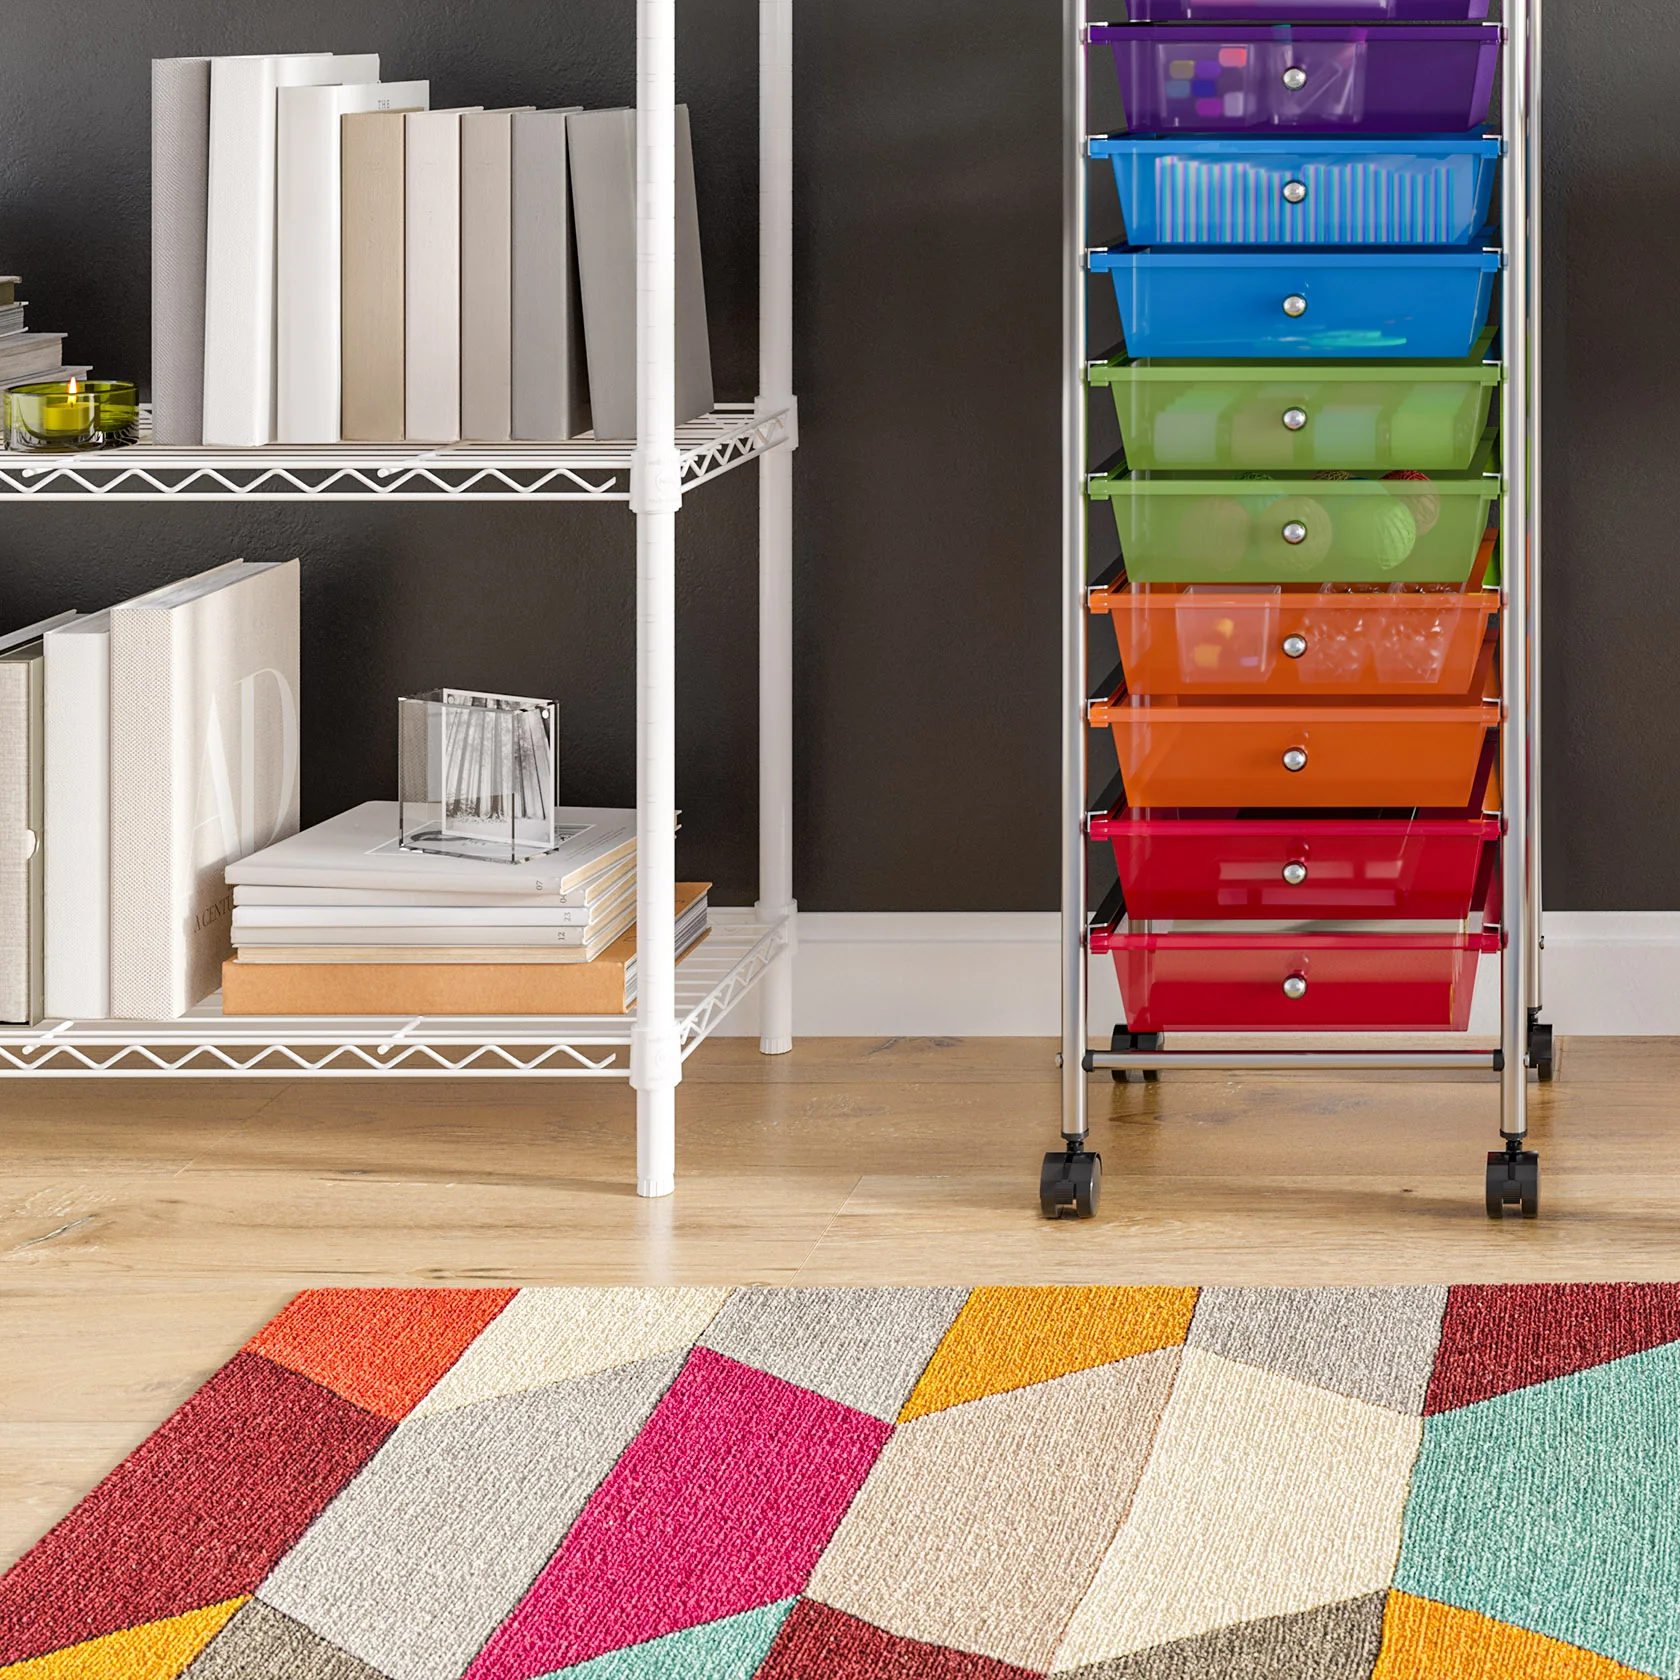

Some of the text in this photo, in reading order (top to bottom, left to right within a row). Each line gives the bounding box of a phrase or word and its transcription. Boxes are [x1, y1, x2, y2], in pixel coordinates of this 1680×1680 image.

[377, 99, 391, 109] THE
[182, 668, 298, 898] AD
[535, 879, 544, 891] 07
[563, 911, 572, 922] 23
[557, 931, 566, 941] 12
